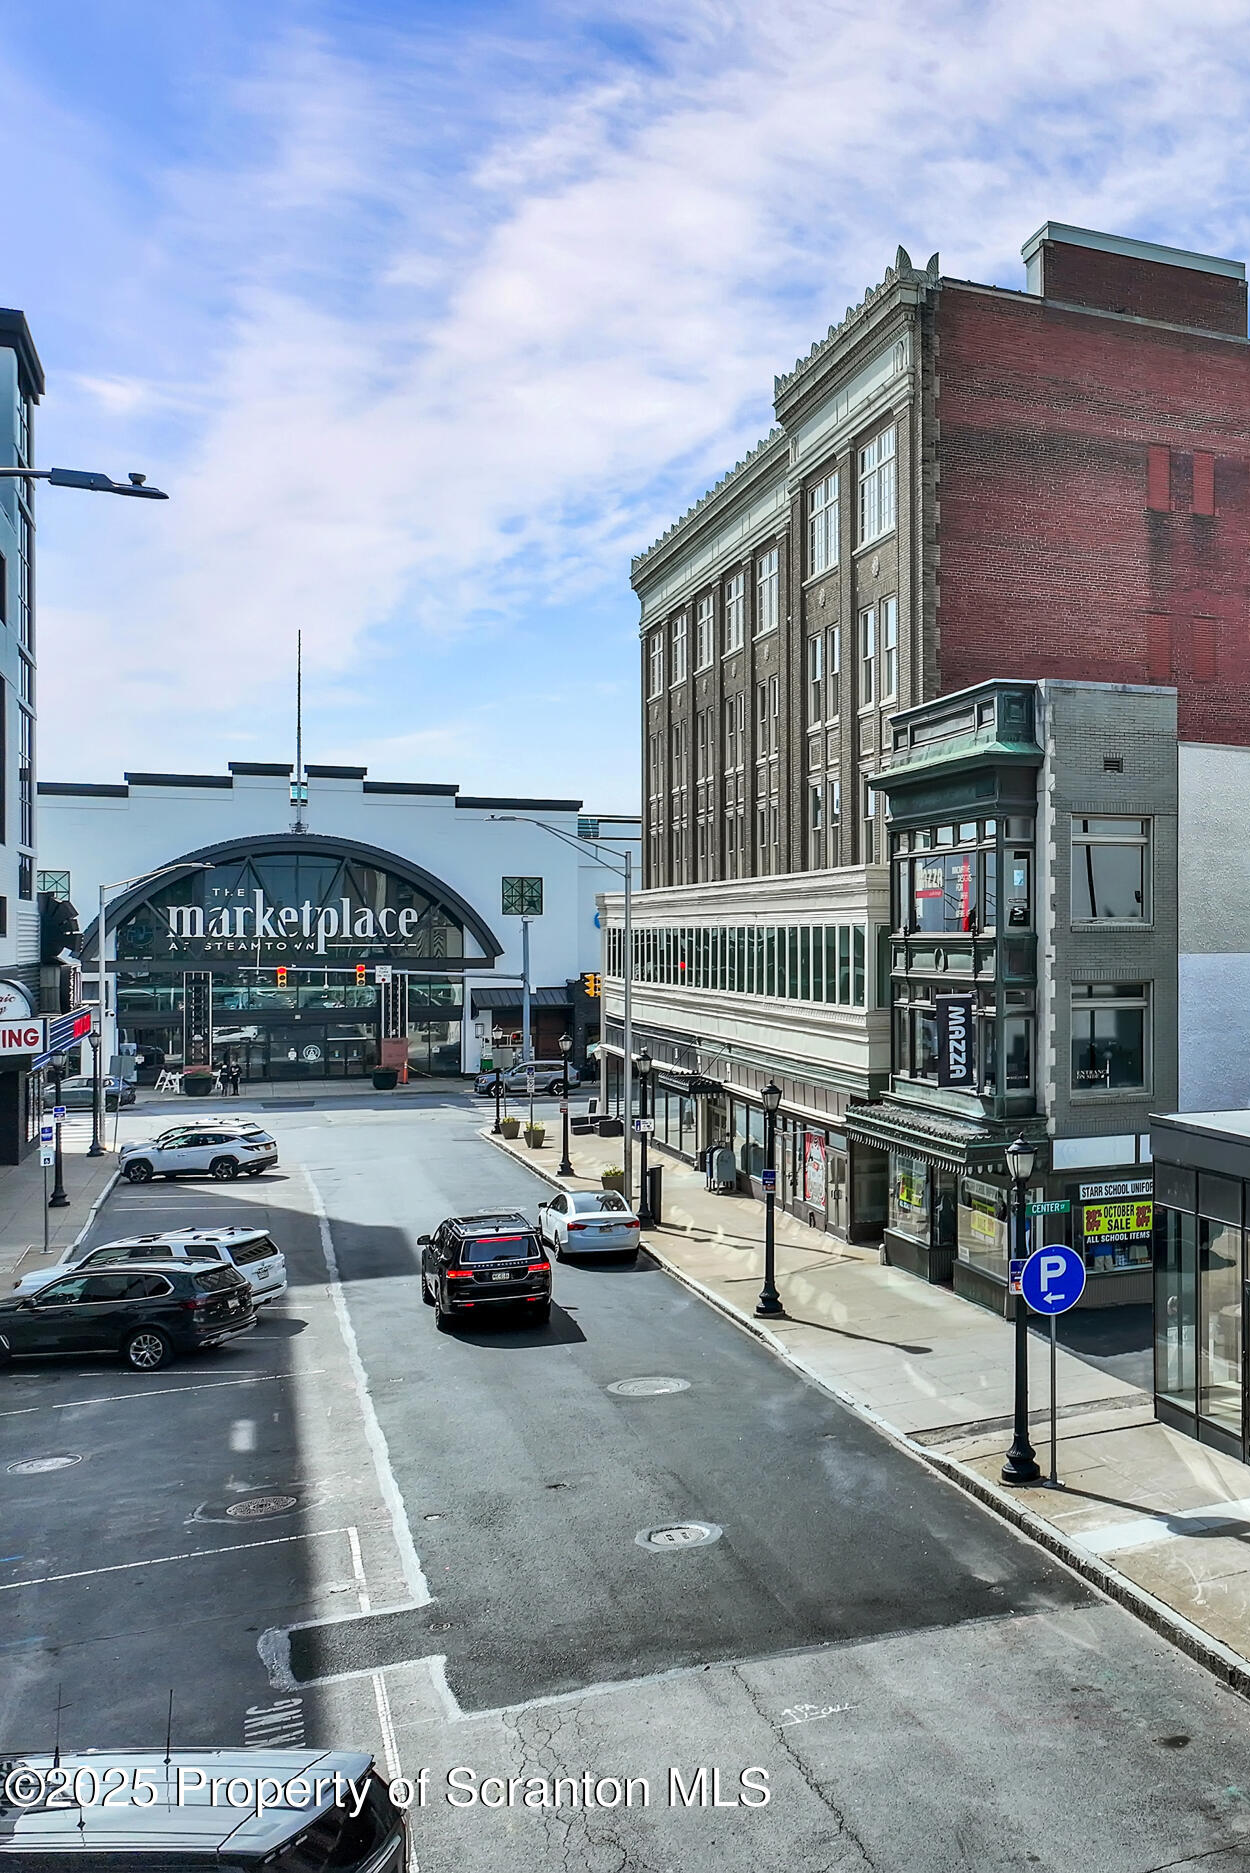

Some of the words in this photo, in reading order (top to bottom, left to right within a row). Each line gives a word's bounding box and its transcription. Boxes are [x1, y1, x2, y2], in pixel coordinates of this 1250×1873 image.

[167, 889, 419, 955] marketplace
[0, 1028, 40, 1049] ING
[948, 1006, 967, 1079] MAZZA
[1081, 1186, 1103, 1198] STARR
[1104, 1183, 1129, 1195] SCHOOL
[1031, 1202, 1060, 1214] CENTER
[1103, 1204, 1134, 1218] OCTOBER
[1107, 1218, 1131, 1231] SALE
[1086, 1236, 1100, 1244] ALL
[1100, 1233, 1128, 1243] SCHOOL
[1129, 1230, 1150, 1240] ITEMS
[1040, 1255, 1067, 1293] P
